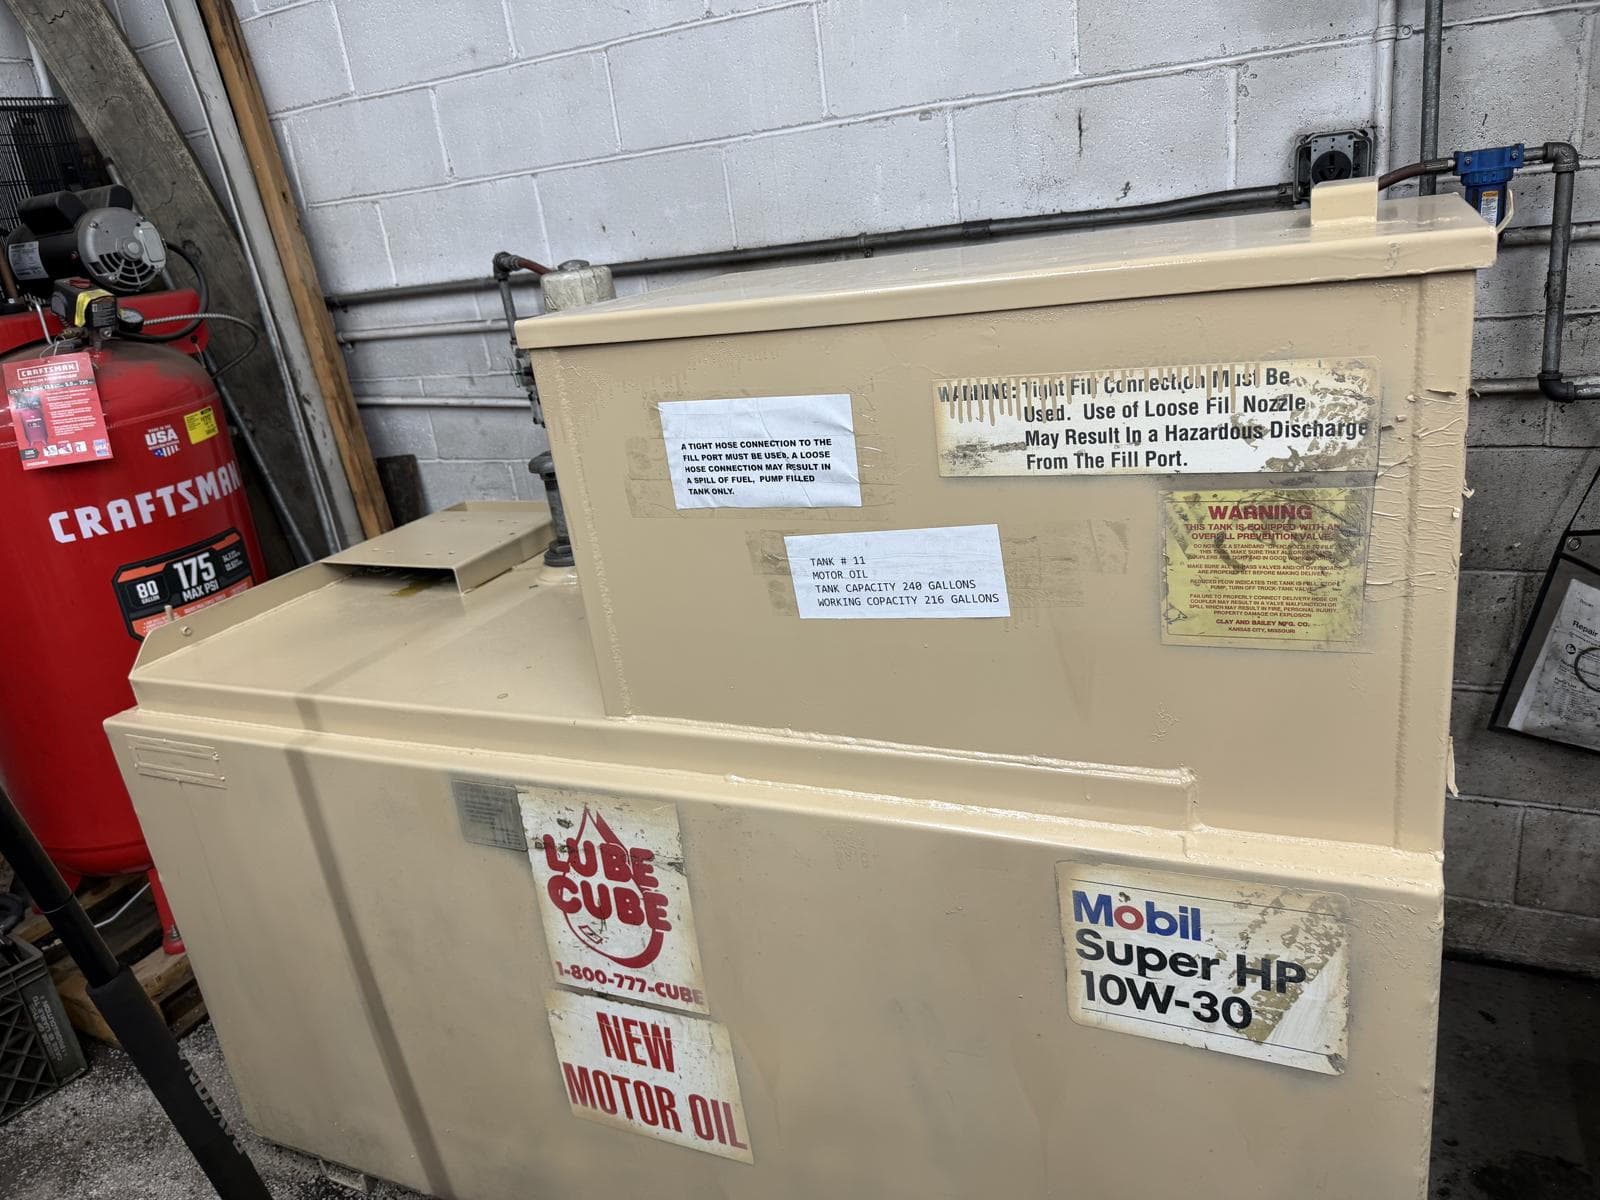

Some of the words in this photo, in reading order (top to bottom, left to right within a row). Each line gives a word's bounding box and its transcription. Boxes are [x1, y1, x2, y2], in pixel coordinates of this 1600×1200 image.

[21, 363, 75, 377] CRAFTSMAN
[1266, 367, 1290, 386] Be
[1024, 404, 1071, 422] Used.
[1083, 402, 1115, 420] Use
[1122, 400, 1138, 418] of
[1145, 399, 1199, 417] Loose
[1243, 393, 1306, 413] Nozzle
[144, 428, 178, 446] USA
[1025, 430, 1059, 449] May
[1065, 427, 1119, 445] Result
[1148, 429, 1159, 442] a
[1165, 422, 1263, 442] Hazardous
[1270, 419, 1368, 441] Discharge
[688, 442, 712, 450] TIGHT
[715, 441, 738, 449] HOSE
[740, 439, 796, 448] CONNECTION
[813, 438, 832, 446] THE
[701, 453, 723, 461] PORT
[751, 452, 762, 460] BE
[791, 451, 798, 459] A
[800, 451, 831, 459] LOOSE
[1026, 453, 1067, 470] From
[1073, 452, 1105, 469] The
[1111, 451, 1139, 467] Fill
[1145, 450, 1188, 467] Port.
[685, 465, 706, 473] HOSE
[708, 464, 763, 472] CONNECTION
[765, 463, 783, 471] MAY
[785, 463, 818, 471] RESULT
[694, 476, 716, 484] SPILL
[718, 476, 729, 484] OF
[731, 475, 755, 484] FUEL,
[785, 474, 815, 482] FILLED
[711, 487, 735, 495] ONLY.
[49, 460, 241, 544] CRAFTSMAN
[1208, 504, 1312, 520] WARNING
[1184, 523, 1205, 531] THIS
[1208, 523, 1232, 531] TANK
[1236, 523, 1244, 531] IS
[1248, 523, 1296, 531] EQUIPPED
[1300, 523, 1324, 531] WITH
[1327, 523, 1340, 531] AN
[1237, 532, 1296, 540] PREVENTION
[173, 551, 216, 590] 175
[810, 556, 835, 567] TANK
[840, 556, 847, 565] #
[853, 555, 866, 565] 11
[812, 570, 843, 580] MOTOR
[849, 569, 868, 579] OIL
[136, 580, 159, 599] 80
[182, 585, 204, 602] MAX
[203, 579, 219, 594] PSI
[815, 584, 840, 593] TANK
[845, 582, 896, 593] CAPACITY
[902, 581, 922, 591] 240
[928, 579, 976, 590] GALLONS
[817, 596, 861, 607] WORKING
[867, 595, 918, 606] COPACITY
[924, 595, 945, 605] 216
[951, 593, 1000, 604] GALLONS
[1572, 619, 1599, 637] Repair
[543, 834, 659, 888] LUBE
[547, 875, 672, 932] CUBE
[1072, 890, 1201, 941] Mobil
[1075, 928, 1219, 981] Super
[1236, 955, 1307, 993] HP
[556, 961, 704, 1005] 1-800-777-CUBE
[1080, 970, 1252, 1030] 10W-30
[596, 1011, 675, 1073] NEW
[562, 1061, 682, 1133] MOTOR
[688, 1094, 748, 1150] OIL
